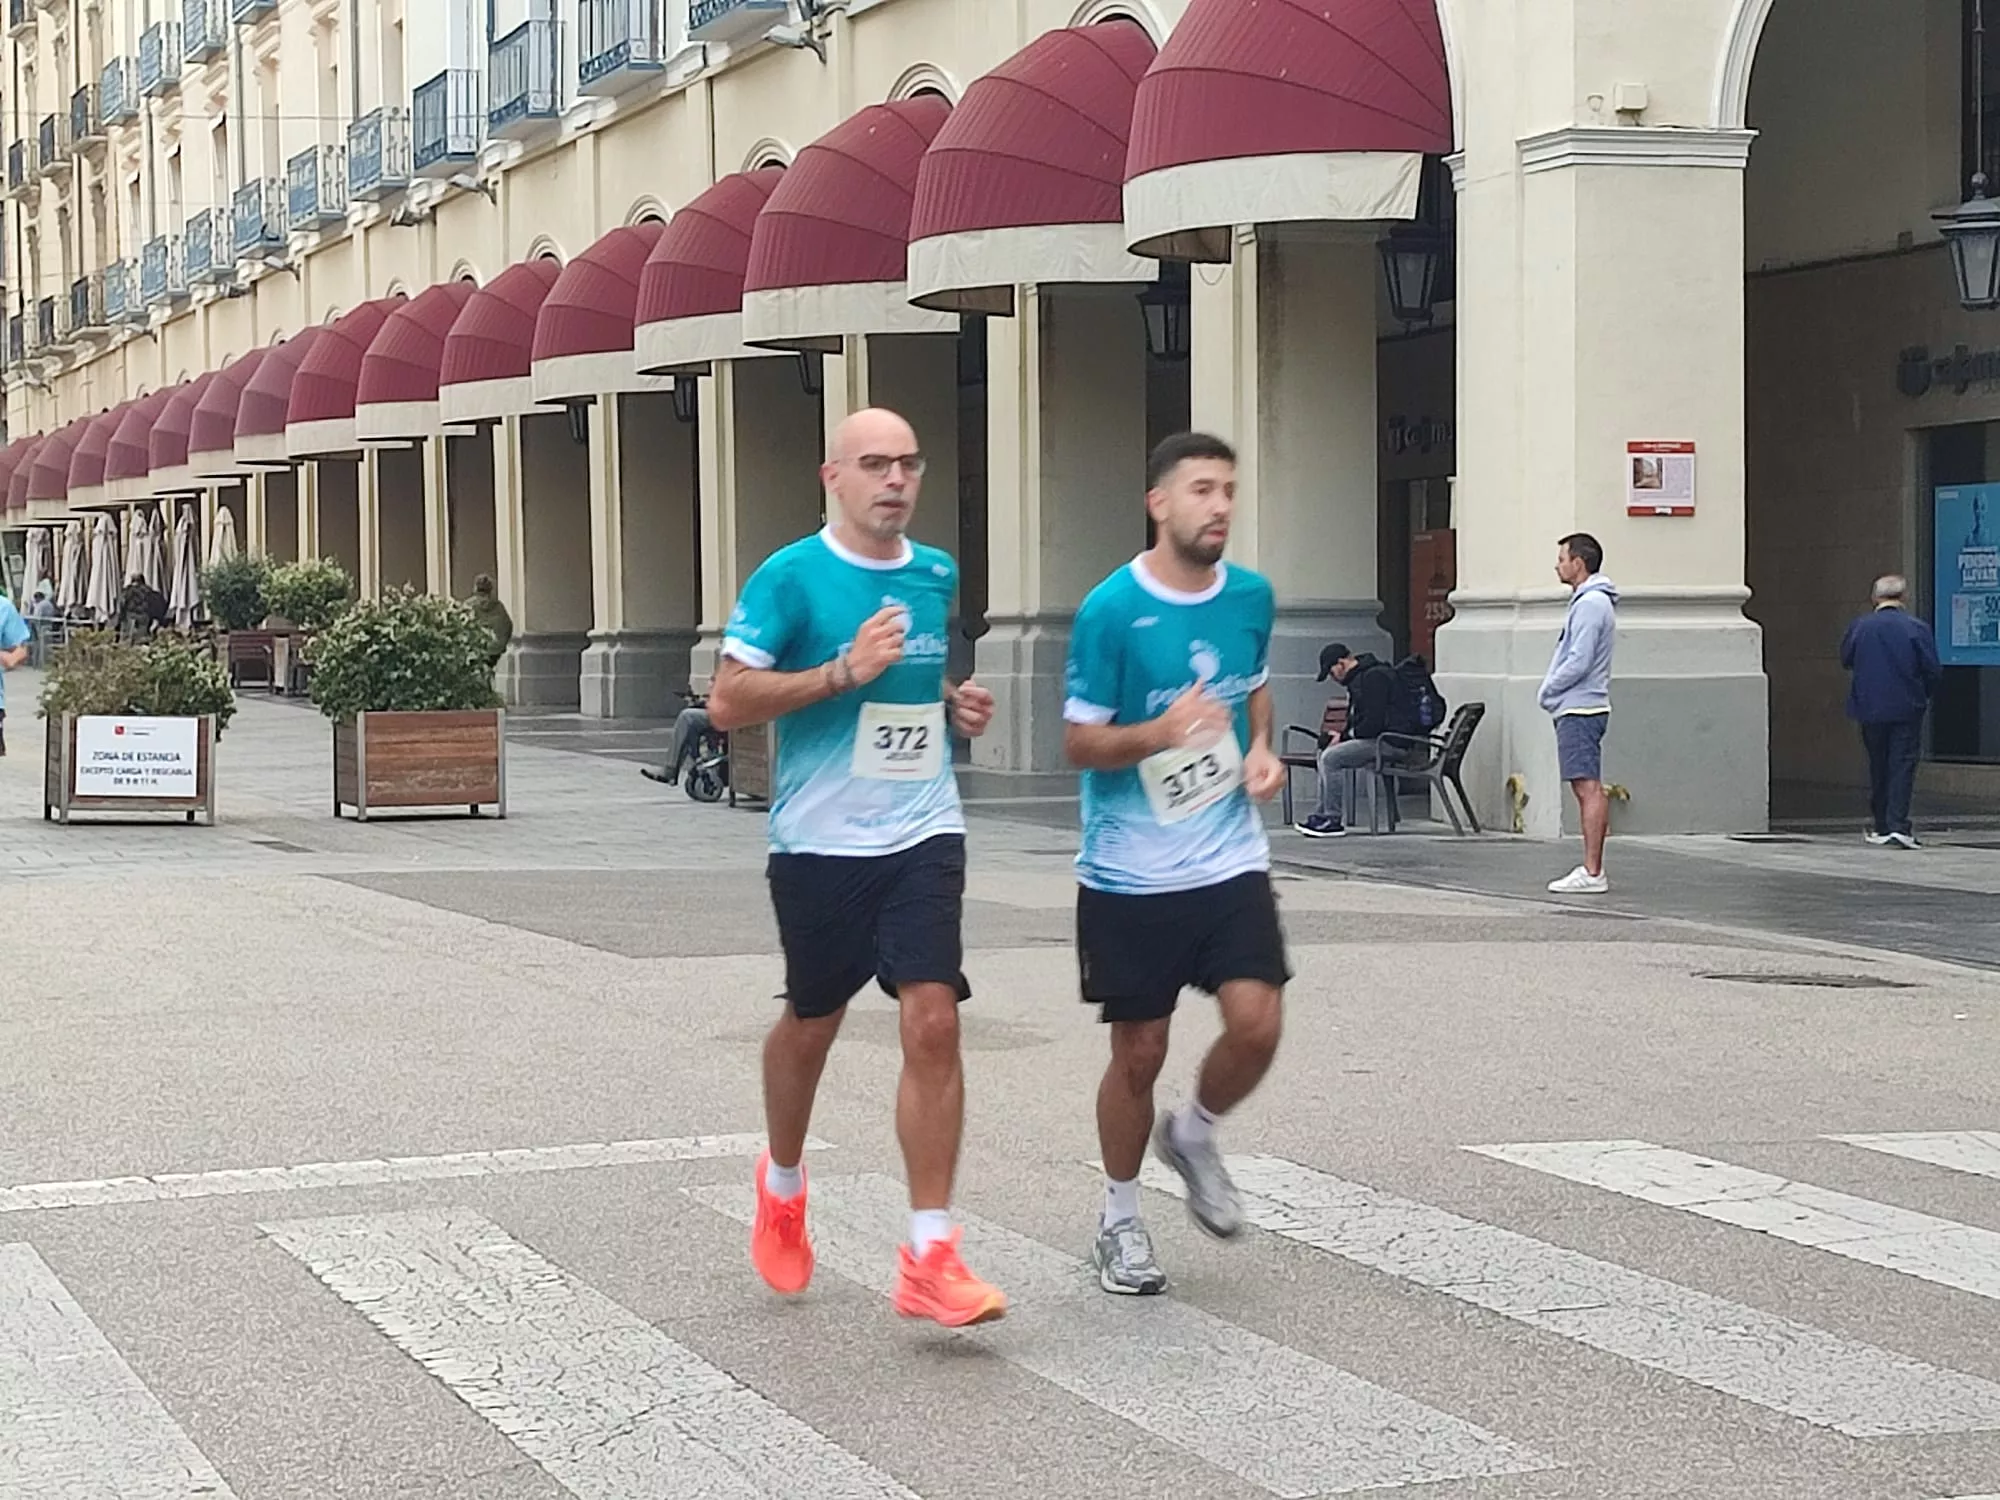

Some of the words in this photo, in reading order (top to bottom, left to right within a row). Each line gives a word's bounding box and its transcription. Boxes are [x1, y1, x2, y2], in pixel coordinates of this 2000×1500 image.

[873, 725, 928, 750] 372
[92, 751, 119, 761] ZONA
[122, 752, 134, 761] DE
[137, 752, 180, 762] ESTANCIA
[80, 766, 114, 775] EXCEPTO
[116, 767, 142, 775] CARGA
[152, 768, 192, 776] DESCARGA
[1161, 753, 1220, 797] 373
